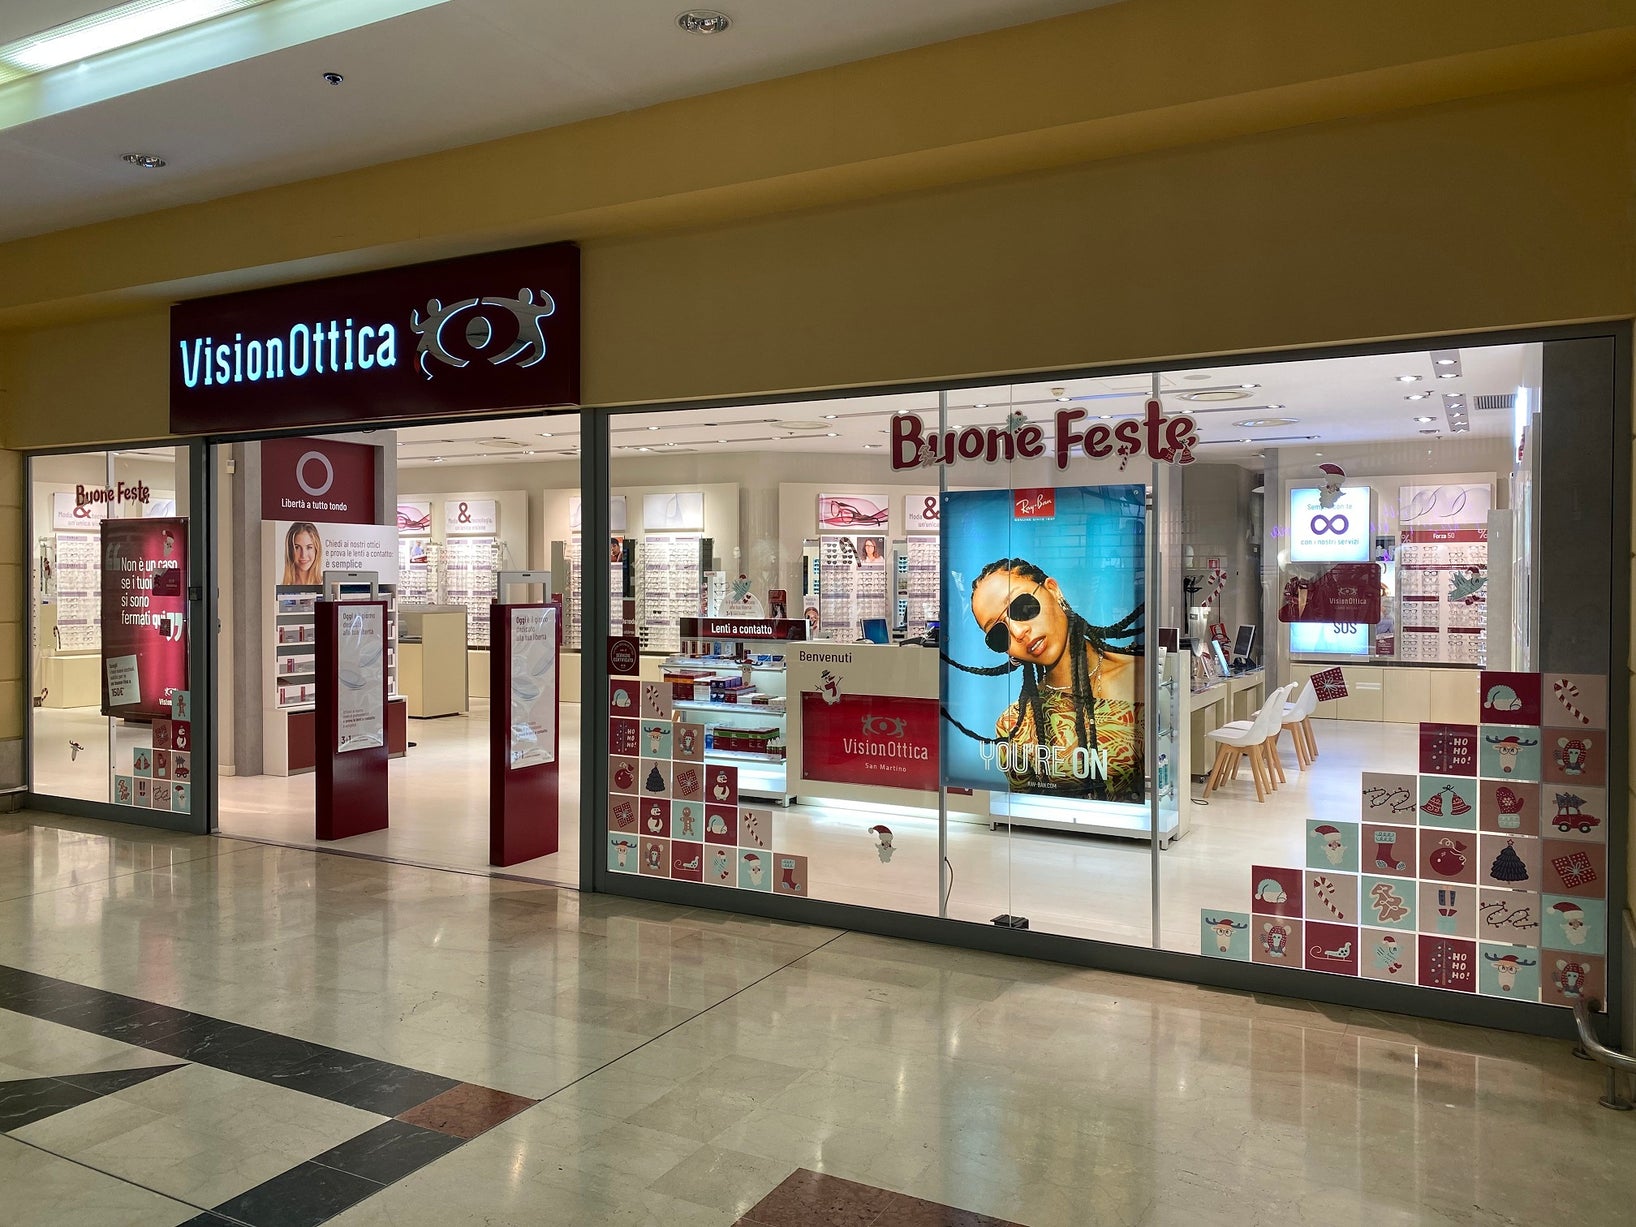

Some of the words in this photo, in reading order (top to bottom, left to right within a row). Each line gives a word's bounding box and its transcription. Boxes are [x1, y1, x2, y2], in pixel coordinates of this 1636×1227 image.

[179, 318, 398, 388] VisionOttica
[891, 413, 1045, 471] Buone
[1055, 398, 1199, 471] Feste
[76, 484, 115, 506] Buone
[118, 480, 150, 504] Feste
[281, 498, 306, 509] Libertà
[306, 501, 312, 509] a
[312, 501, 329, 510] tutto
[329, 502, 348, 511] tondo
[458, 502, 471, 523] &
[325, 539, 343, 548] Chiedi
[344, 540, 350, 548] ai
[350, 540, 366, 549] nostri
[367, 540, 381, 549] ottici
[1337, 538, 1360, 546] servizi
[330, 550, 346, 558] prova
[121, 557, 137, 571] Non
[139, 557, 144, 571] è
[145, 559, 156, 572] un
[325, 559, 330, 568] è
[331, 560, 363, 570] semplice
[121, 577, 131, 589] se
[132, 574, 136, 589] i
[137, 574, 153, 590] tuoi
[121, 592, 128, 607] si
[129, 595, 150, 608] sono
[1329, 597, 1367, 605] VisionOttica
[121, 610, 151, 625] fermati
[711, 622, 731, 634] Lenti
[732, 625, 738, 634] a
[739, 624, 773, 635] contatto
[1333, 621, 1358, 635] SOS
[799, 650, 852, 663] Benvenuti
[843, 737, 928, 760] VisionOttica
[1453, 738, 1469, 746] HO
[1453, 747, 1468, 756] HO
[979, 740, 1067, 777] YOU'RE
[1072, 746, 1108, 781] ON
[1452, 756, 1472, 765] HO!
[879, 764, 907, 773] Martino
[1452, 952, 1467, 961] HO
[1452, 962, 1467, 971] HO
[1451, 971, 1471, 981] HO!
